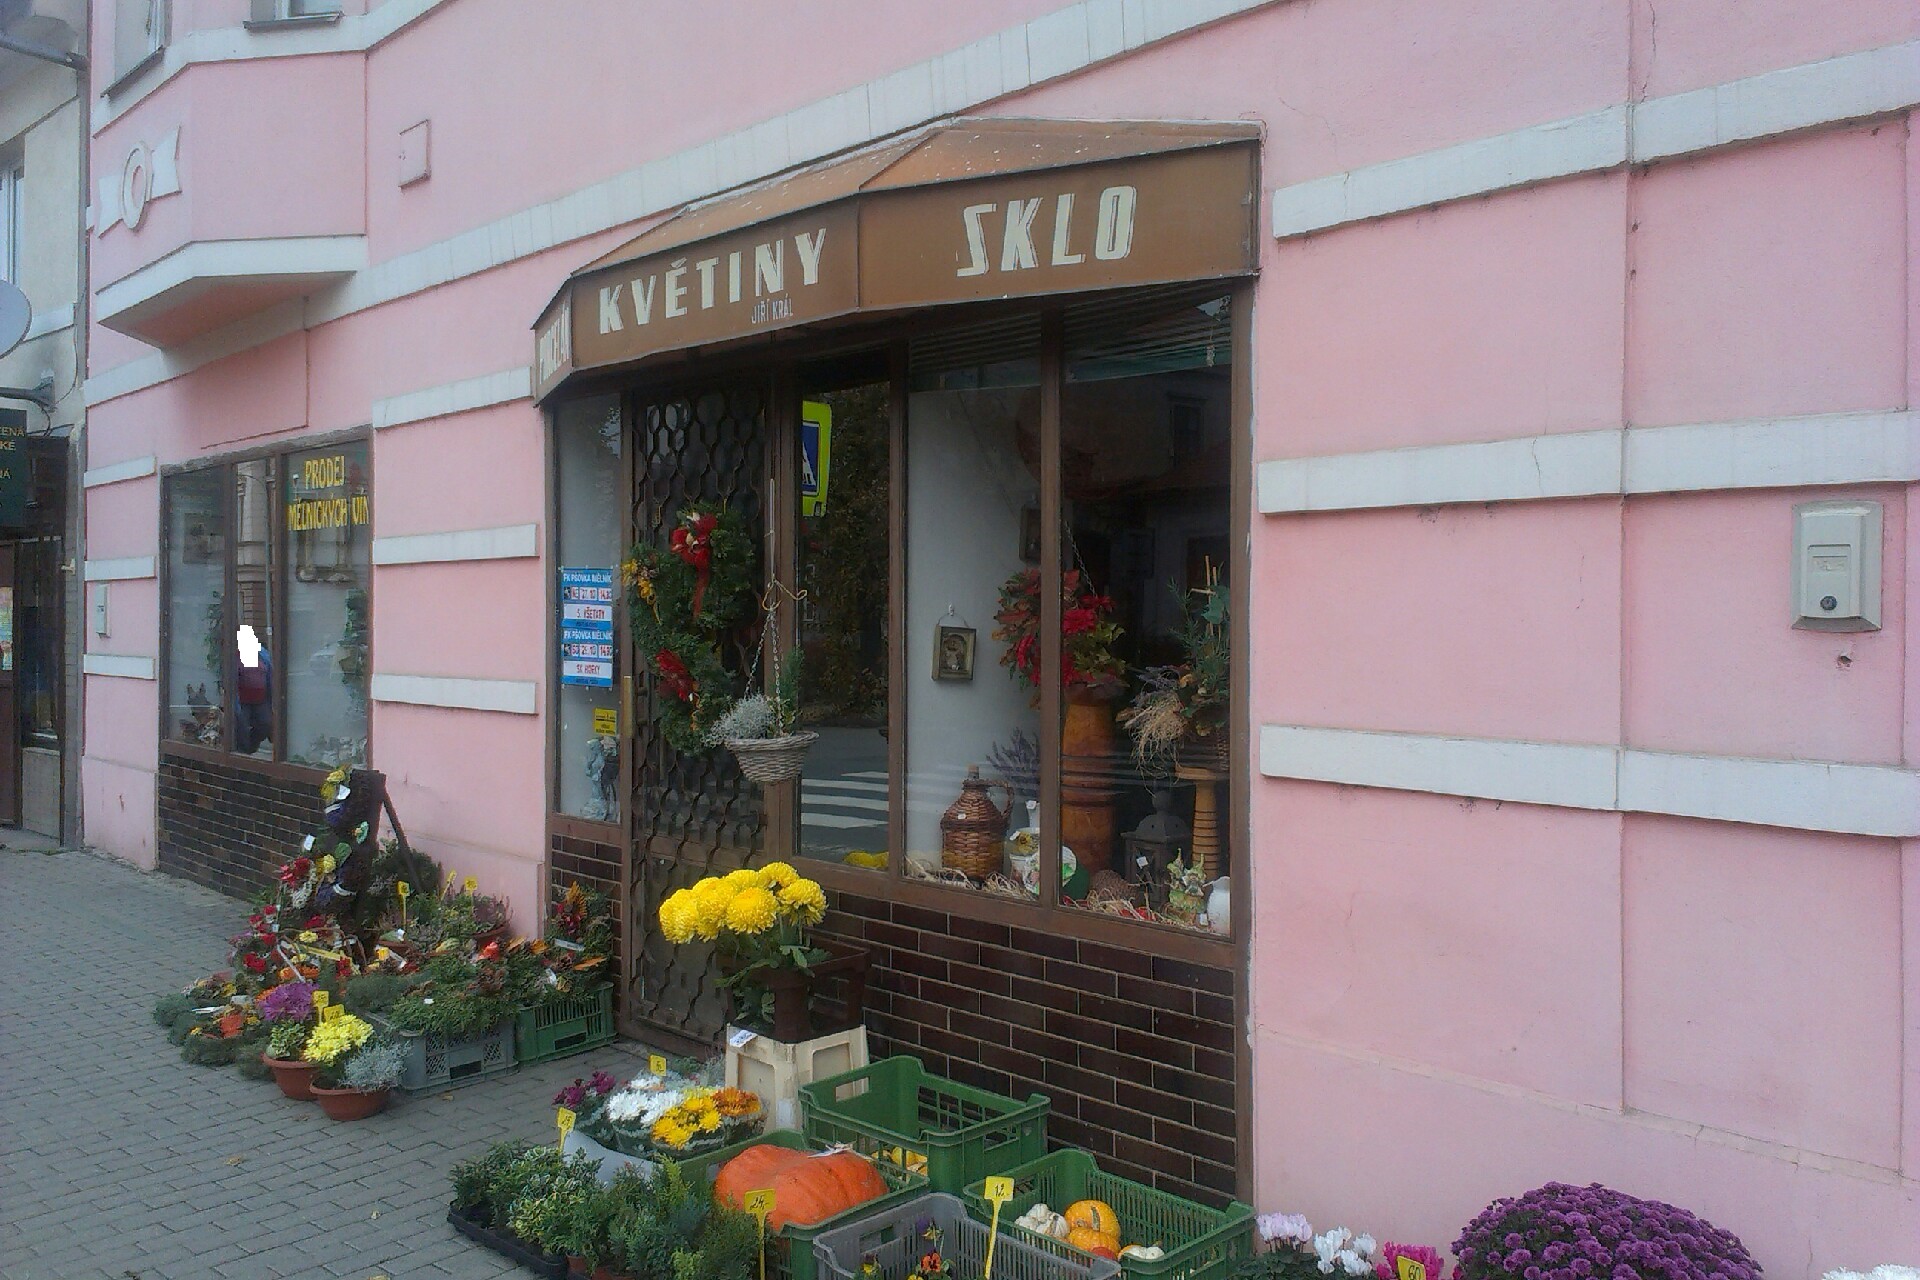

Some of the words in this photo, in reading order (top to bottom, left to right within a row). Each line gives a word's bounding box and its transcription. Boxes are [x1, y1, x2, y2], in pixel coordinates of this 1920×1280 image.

[956, 184, 1138, 278] SKLO
[599, 227, 827, 335] KVĚTINY
[305, 455, 345, 490] PRODEJ
